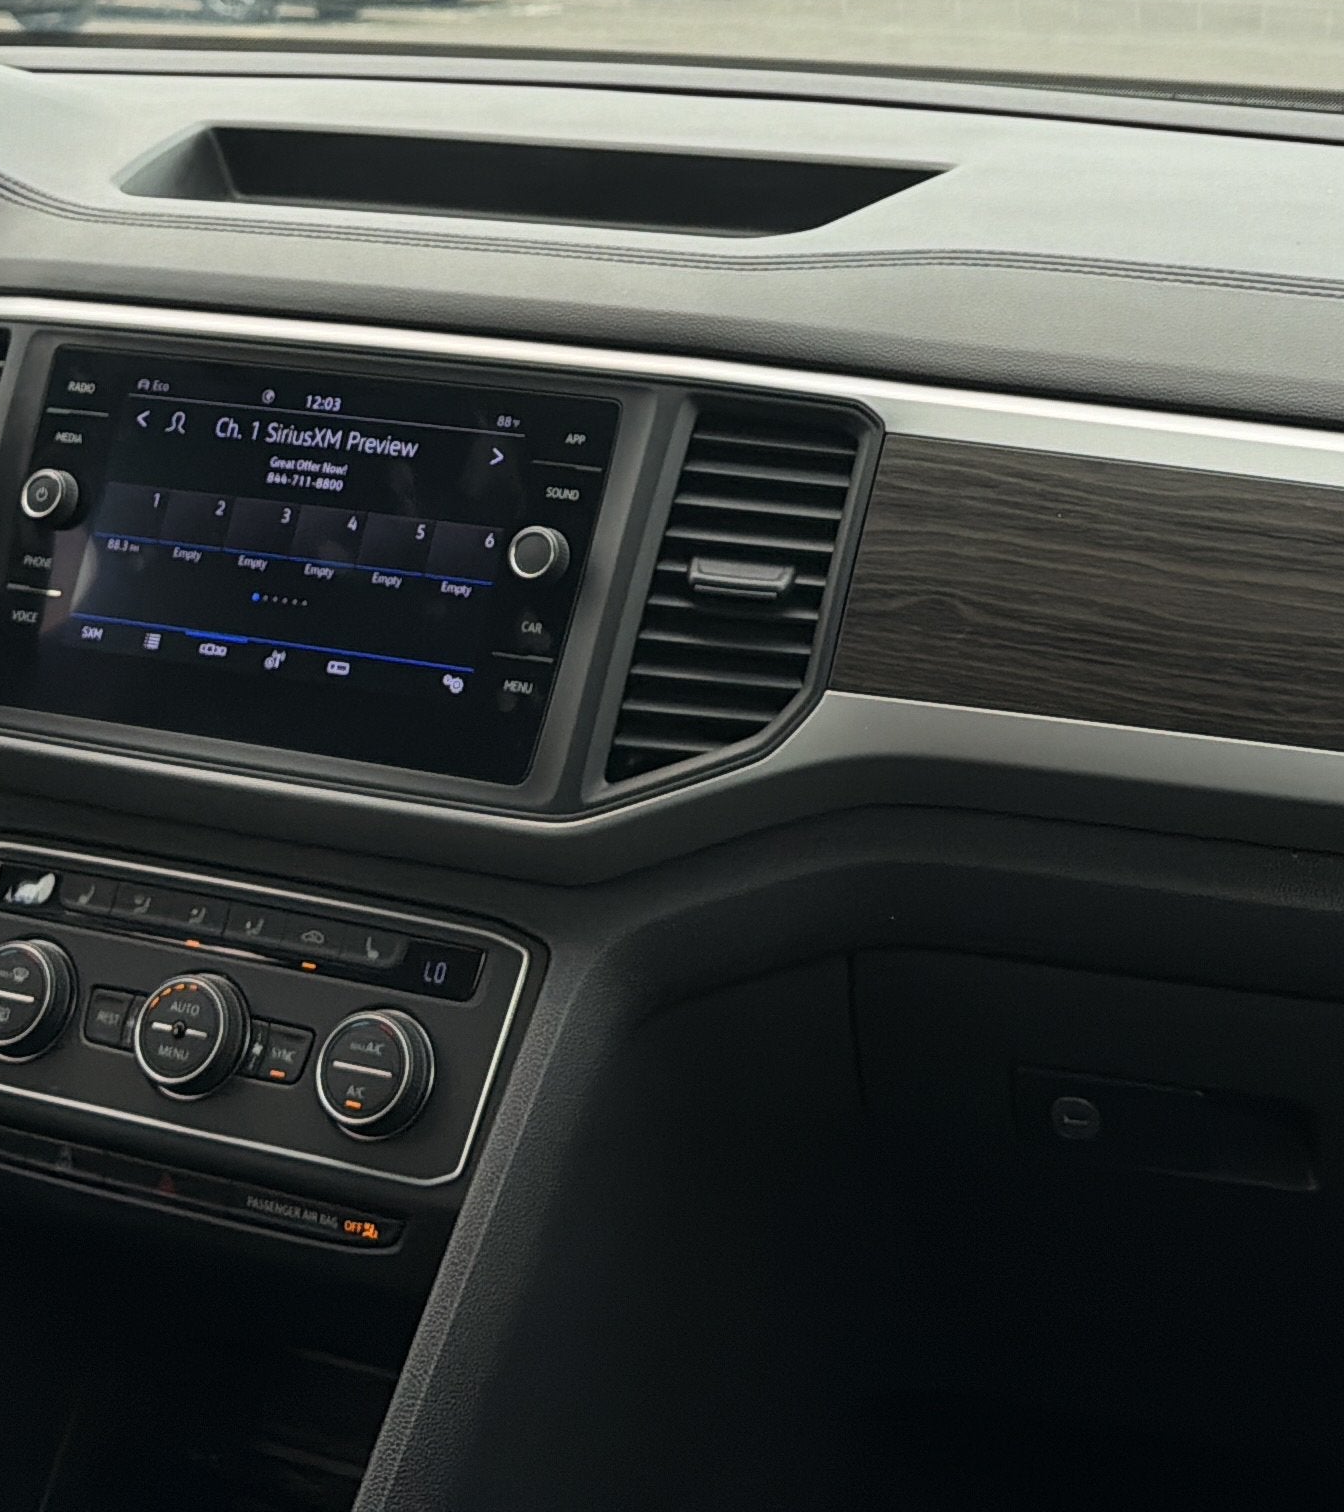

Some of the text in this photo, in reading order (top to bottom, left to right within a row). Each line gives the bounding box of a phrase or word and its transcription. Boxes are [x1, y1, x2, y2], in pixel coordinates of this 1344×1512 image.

[67, 380, 96, 395] RADIO
[152, 380, 170, 393] Eco
[305, 394, 342, 412] 12:03
[55, 431, 84, 445] MEDIA
[215, 417, 419, 458] Ch. 1 SiriusXM Preview
[564, 433, 587, 446] APP
[269, 456, 349, 477] Great Offer Now!
[545, 486, 580, 501] SOUND
[215, 499, 226, 516] 2
[281, 507, 292, 523] 3
[347, 516, 358, 531] 4
[415, 524, 426, 540] 5
[484, 533, 495, 548] 6
[23, 554, 53, 569] PHONE
[172, 546, 202, 563] Empty
[237, 554, 268, 572] Empty
[304, 563, 334, 579] Empty
[371, 572, 402, 589] Empty
[440, 580, 472, 598] Empty
[11, 610, 39, 624] VOICE
[81, 624, 104, 641] SXM
[520, 619, 543, 635] CAR
[502, 679, 534, 695] MENU
[170, 1000, 201, 1017] AUTO
[96, 1010, 120, 1024] REST
[157, 1043, 189, 1061] MENU
[270, 1046, 296, 1063] SYNC
[246, 1195, 362, 1233] PASSENGER AIR BAG OFF
